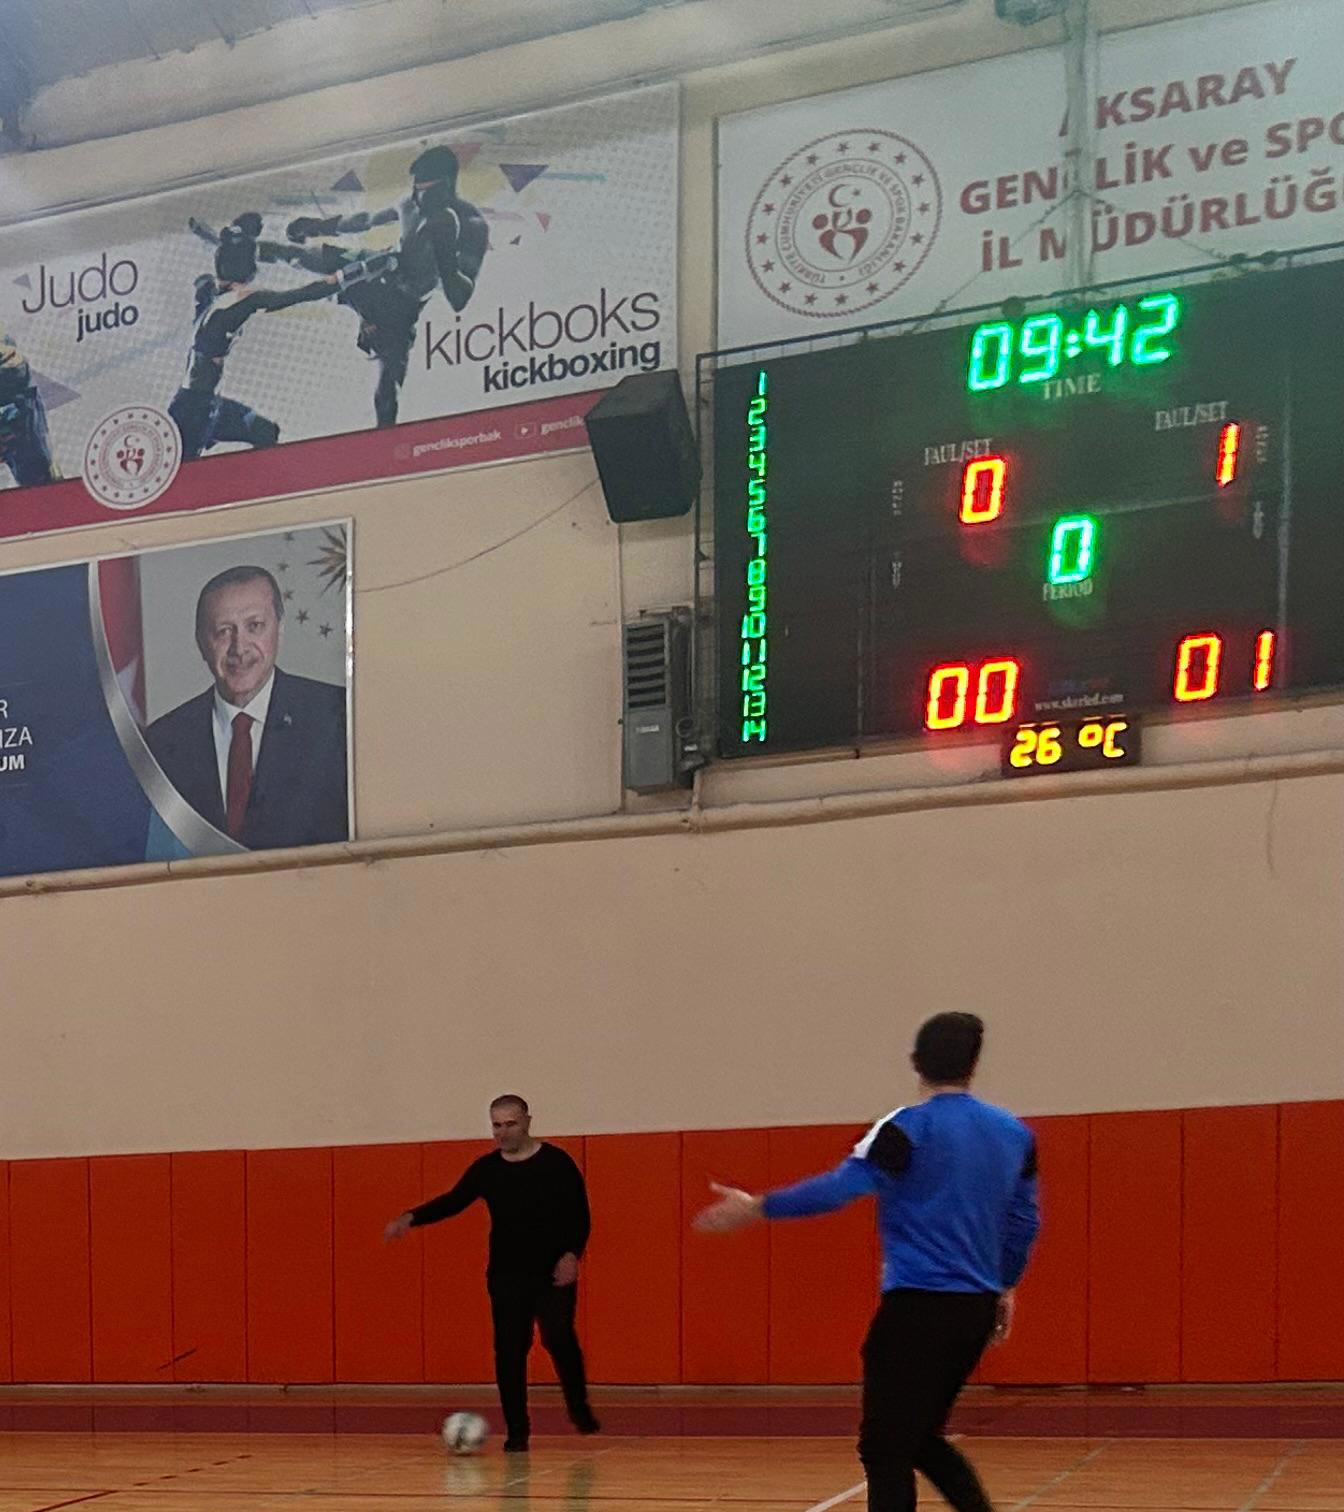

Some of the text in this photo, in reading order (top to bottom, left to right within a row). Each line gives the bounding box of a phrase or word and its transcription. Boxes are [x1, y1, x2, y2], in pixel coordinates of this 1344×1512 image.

[1059, 57, 1298, 137] KSARAY
[1188, 138, 1249, 173] ve
[981, 166, 1344, 273] İL MÜDÜRLÜĞ
[20, 251, 140, 317] Judo
[76, 300, 140, 344] judo
[422, 286, 661, 373] kickboks
[968, 293, 1180, 392] 09:42
[482, 337, 663, 395] kickboxing
[1041, 372, 1103, 400] TIME
[1215, 422, 1242, 489] 1
[960, 456, 1008, 524] 0
[1048, 514, 1098, 585] 0
[925, 657, 1023, 731] 00
[1010, 726, 1062, 768] 26
